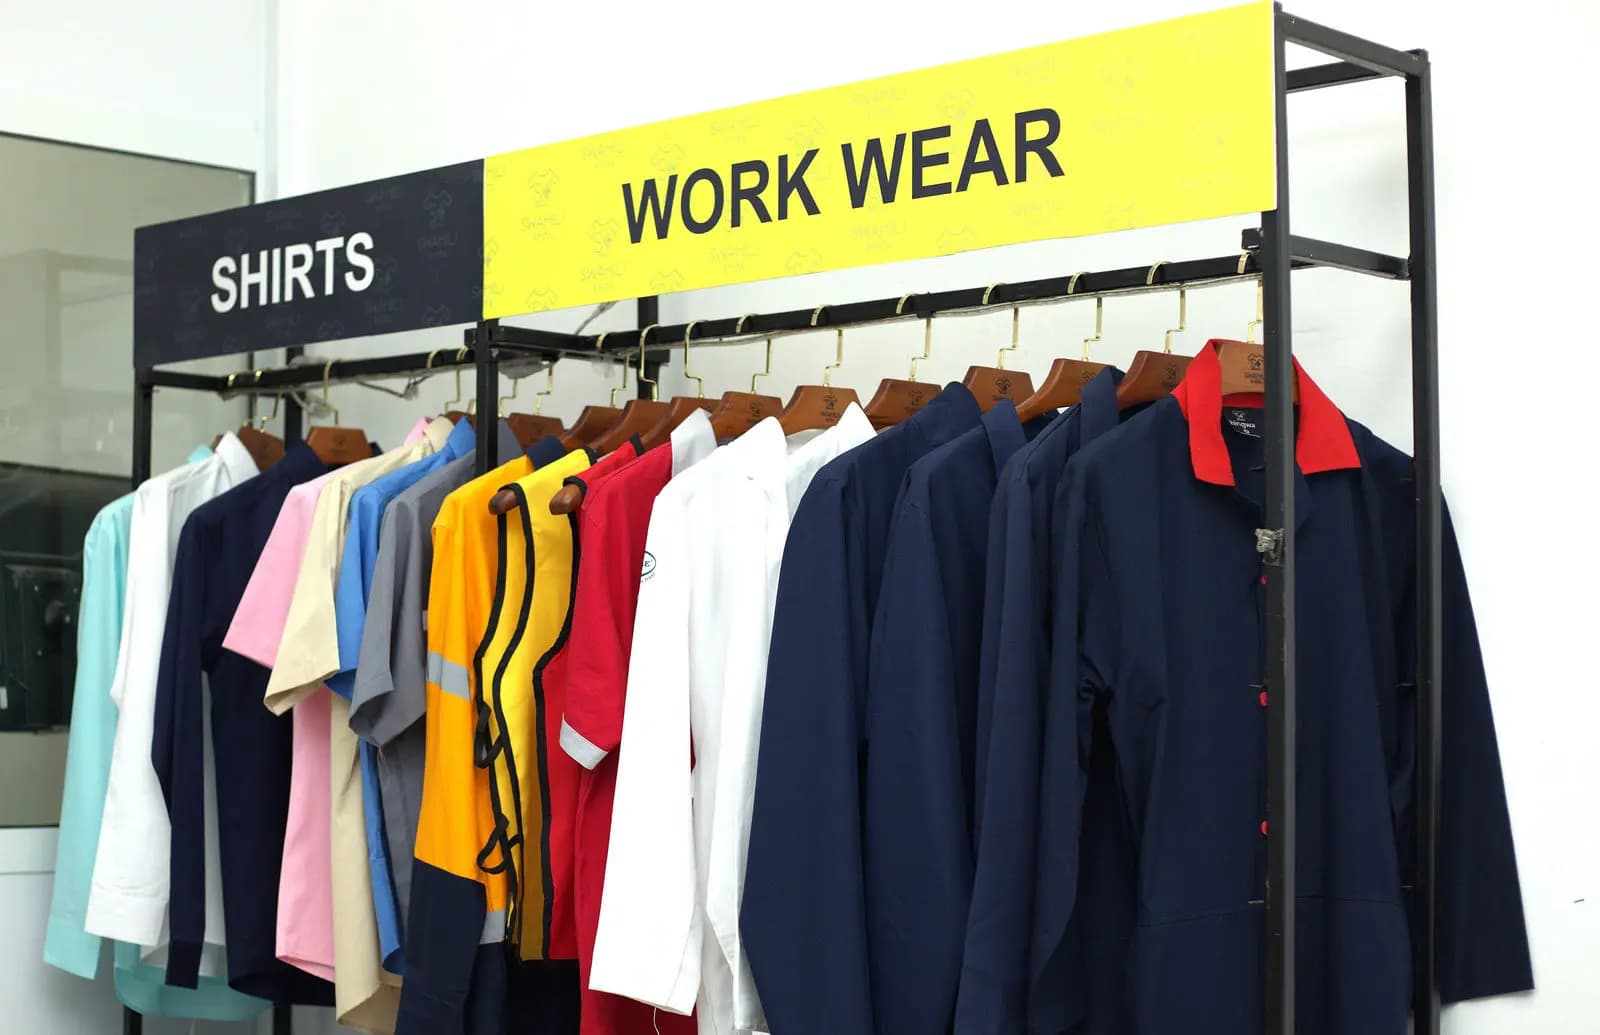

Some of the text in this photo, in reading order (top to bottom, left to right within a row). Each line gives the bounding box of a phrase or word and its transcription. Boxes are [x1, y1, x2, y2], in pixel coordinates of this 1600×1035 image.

[622, 108, 1064, 244] WORK WEAR
[211, 232, 374, 312] SHIRTS
